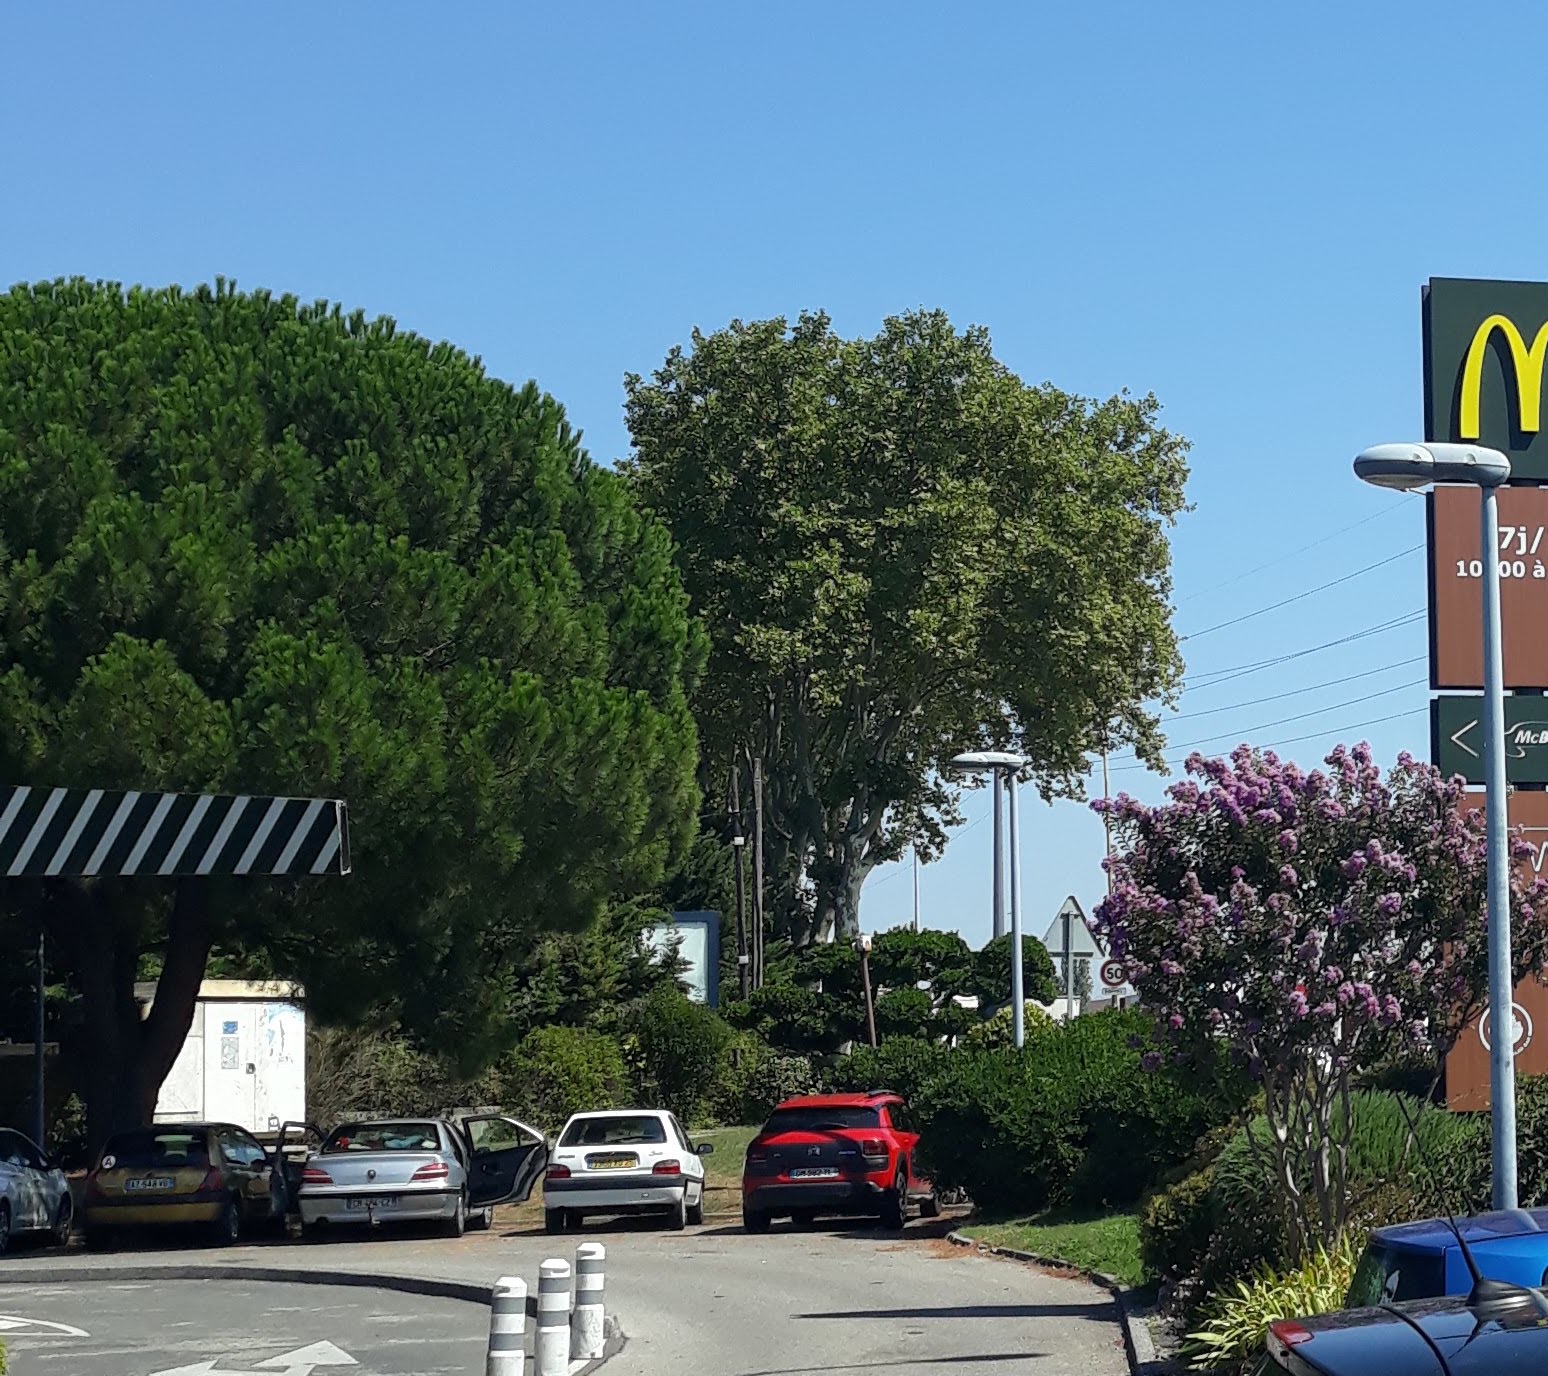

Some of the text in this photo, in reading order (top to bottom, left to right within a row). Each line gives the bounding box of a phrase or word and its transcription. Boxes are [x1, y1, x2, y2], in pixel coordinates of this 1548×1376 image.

[1456, 560, 1526, 578] 1000
[1532, 560, 1546, 578] à
[1106, 967, 1124, 979] 50
